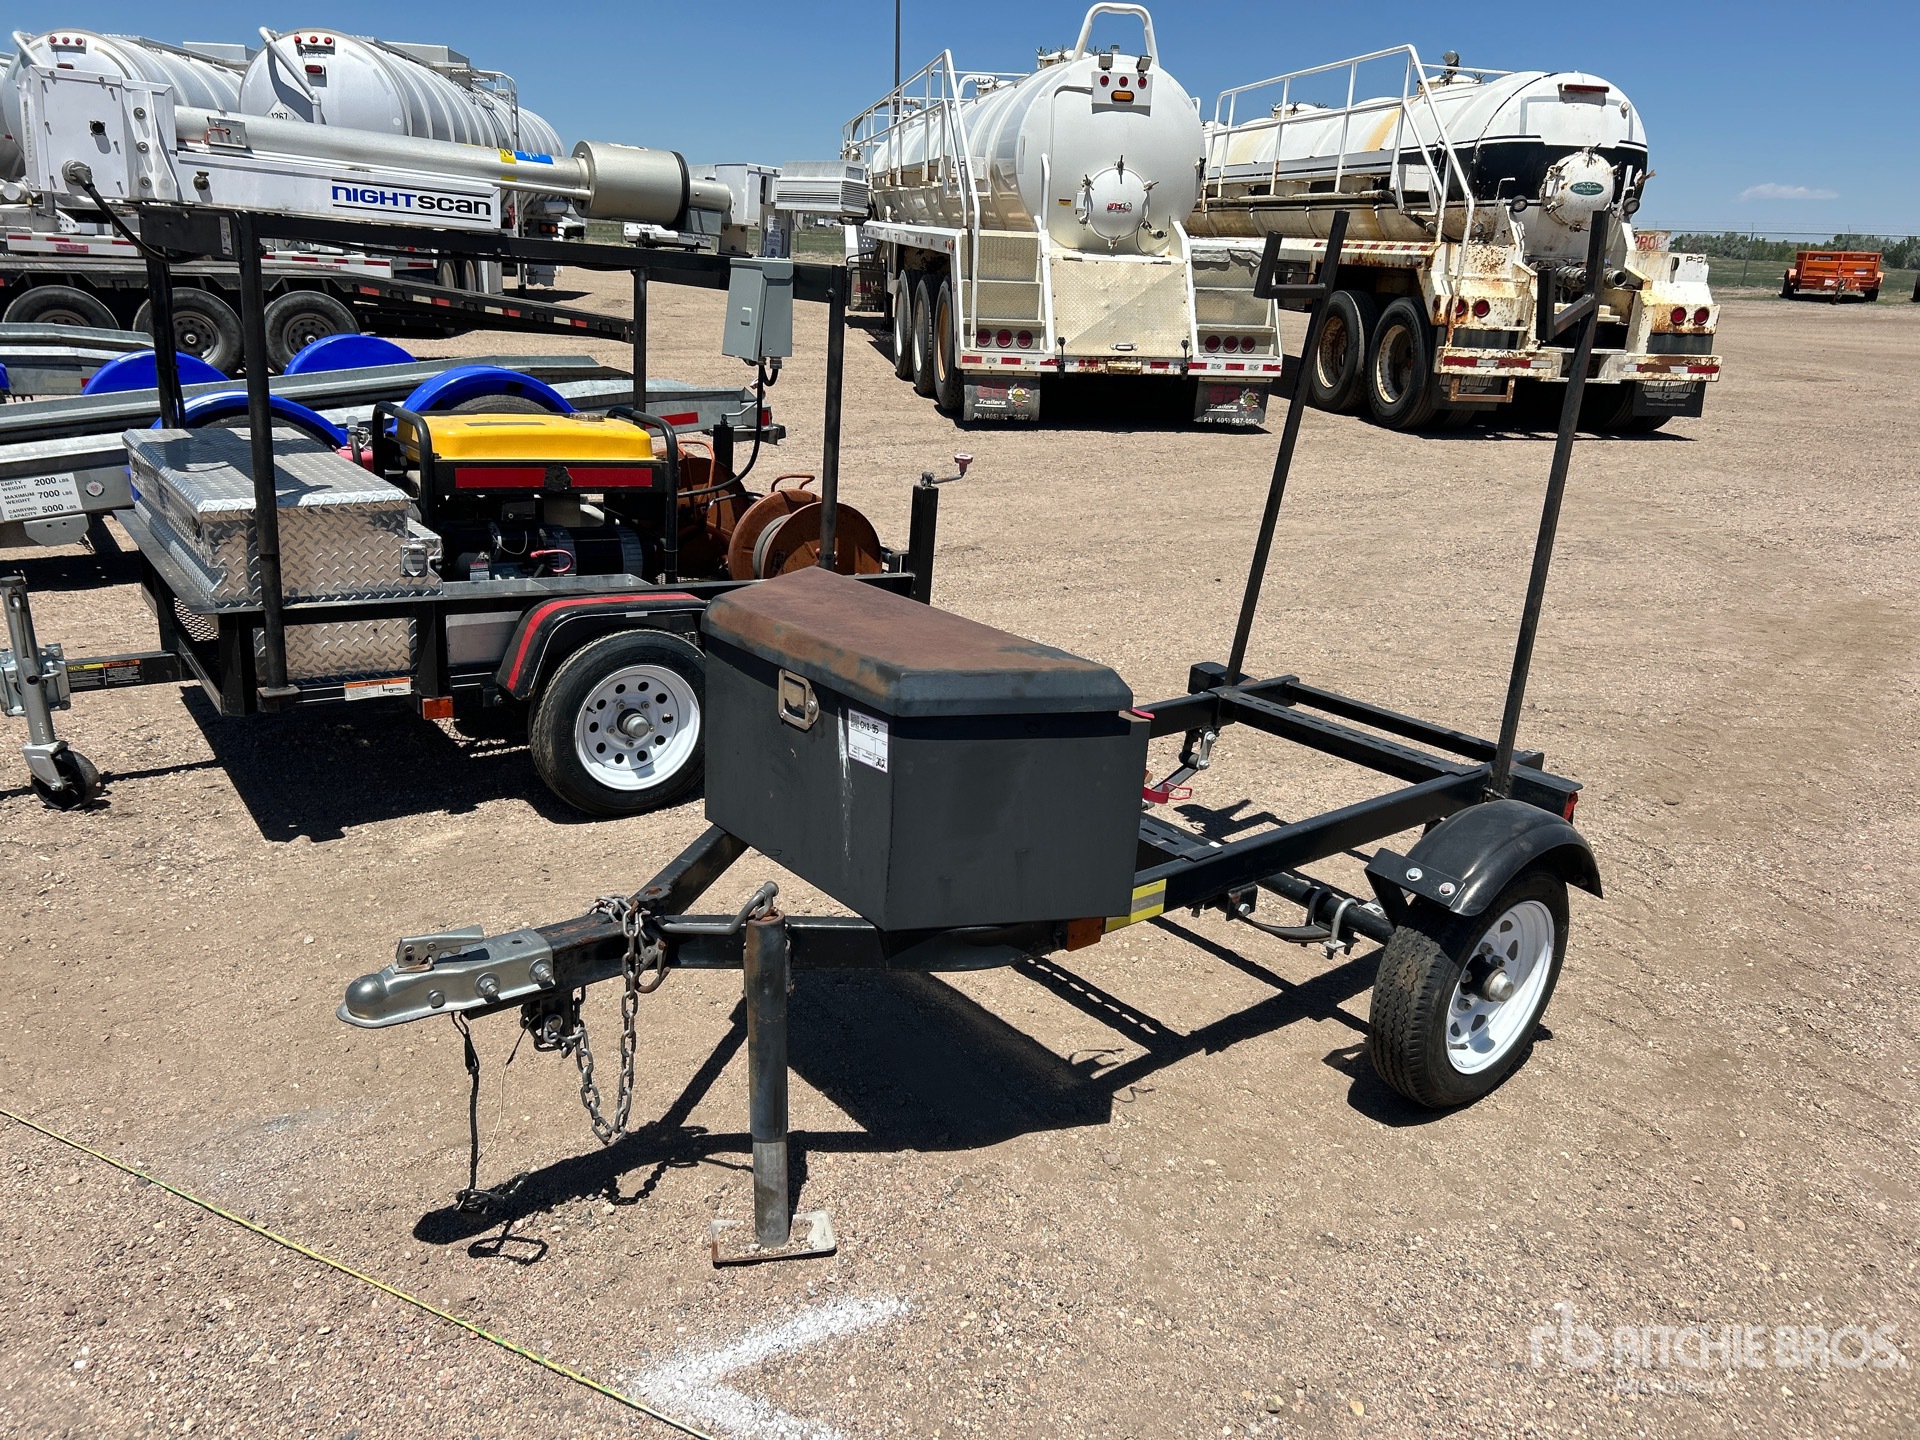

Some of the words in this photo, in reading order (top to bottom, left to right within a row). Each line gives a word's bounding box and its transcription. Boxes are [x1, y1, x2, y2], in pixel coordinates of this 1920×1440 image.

[34, 477, 57, 486] 2000
[4, 492, 35, 500] MAXIMUM
[37, 490, 60, 499] 7000
[8, 506, 38, 514] CARRYING
[42, 504, 64, 513] 5000
